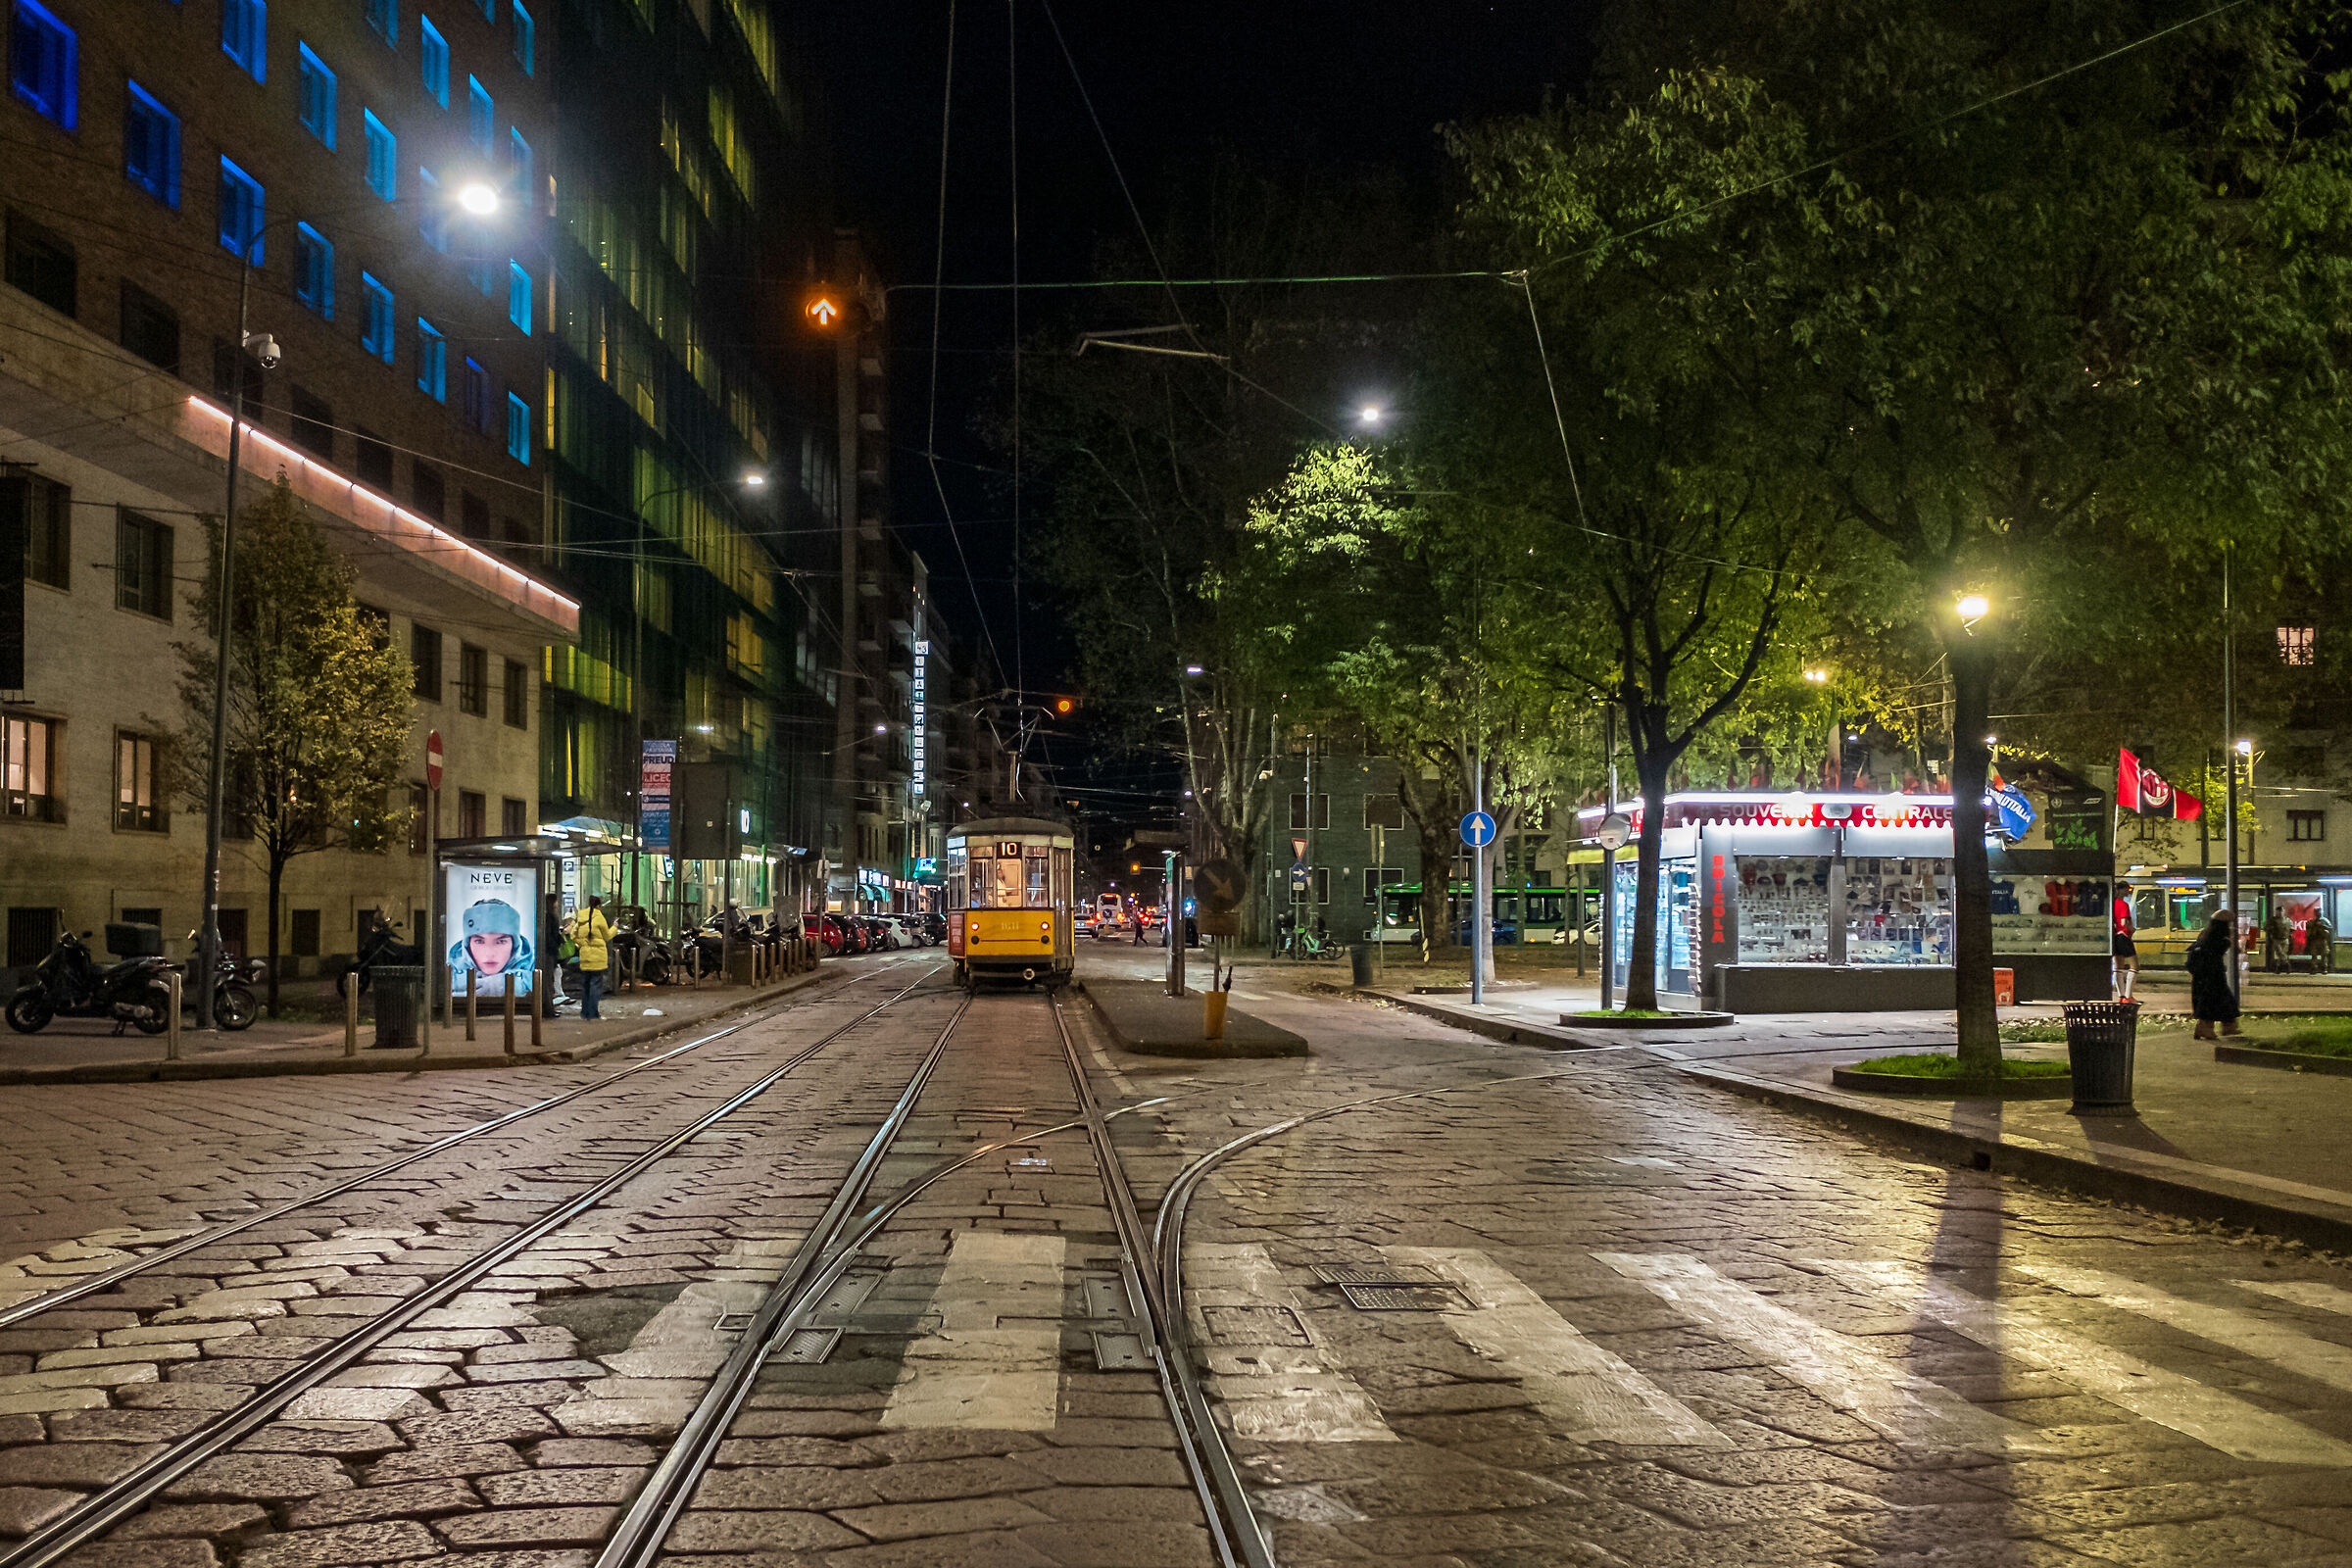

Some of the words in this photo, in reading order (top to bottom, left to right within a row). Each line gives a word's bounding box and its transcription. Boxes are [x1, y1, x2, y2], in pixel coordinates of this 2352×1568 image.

[643, 756, 674, 764] FREUD
[1720, 804, 1814, 818] SOUVENIR
[1862, 804, 1953, 818] CENTRALE
[1001, 842, 1017, 856] 10
[470, 872, 513, 884] NEVE
[1711, 855, 1726, 944] EDICOLA
